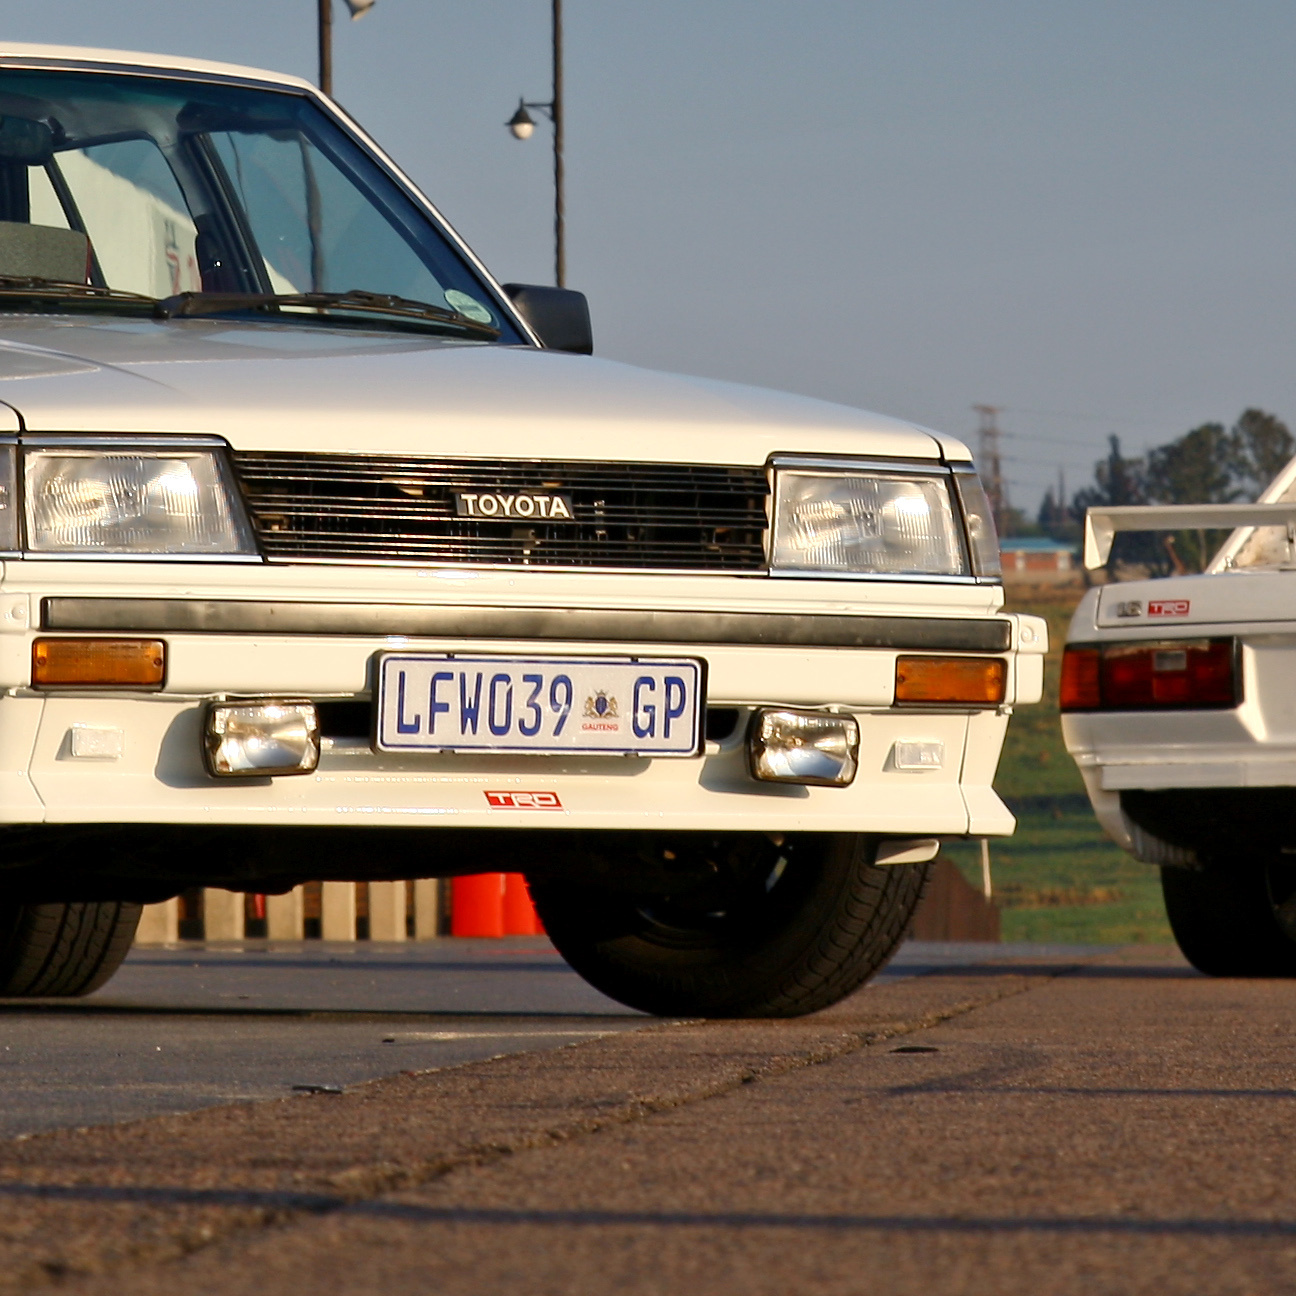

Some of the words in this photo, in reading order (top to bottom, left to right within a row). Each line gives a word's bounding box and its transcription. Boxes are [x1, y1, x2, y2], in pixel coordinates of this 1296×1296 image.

[460, 493, 570, 518] TOYOTA
[396, 670, 574, 737] LFW039
[631, 675, 687, 739] GP
[581, 722, 619, 732] GAUTENG
[486, 791, 560, 809] TRD
